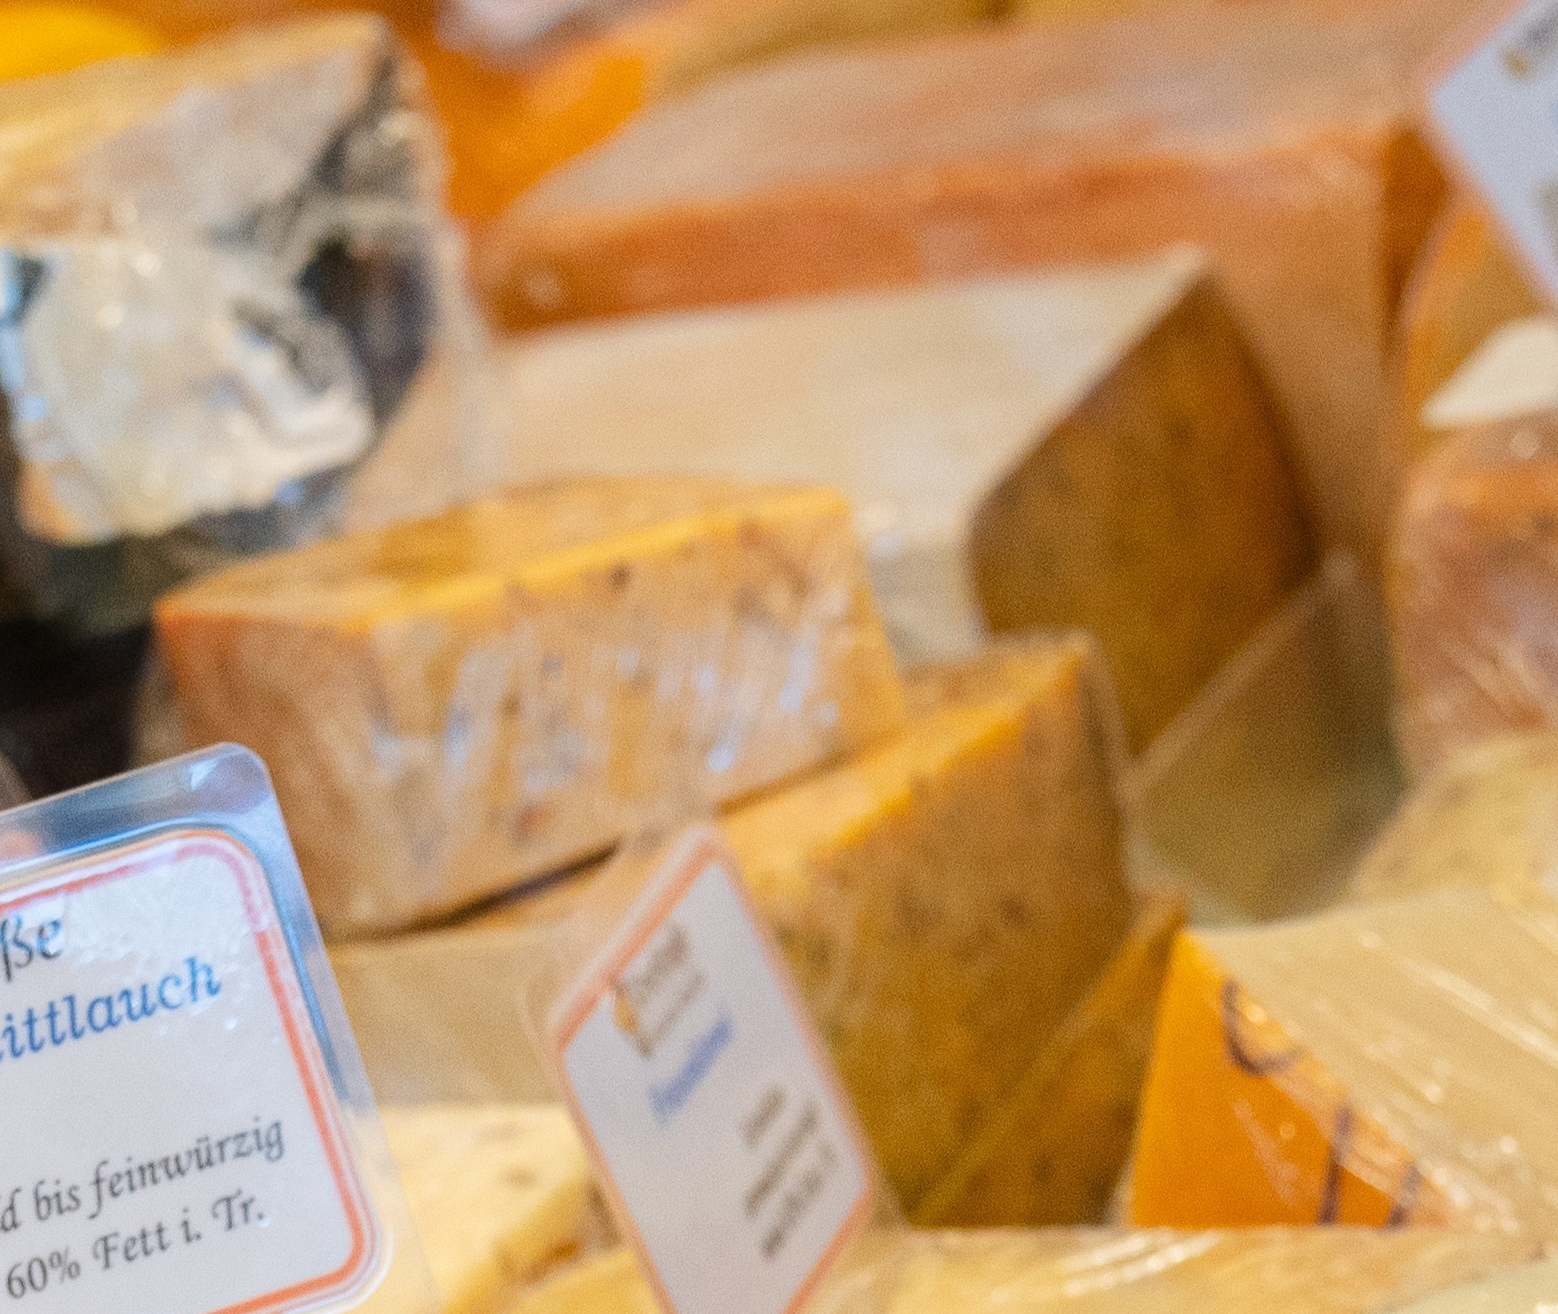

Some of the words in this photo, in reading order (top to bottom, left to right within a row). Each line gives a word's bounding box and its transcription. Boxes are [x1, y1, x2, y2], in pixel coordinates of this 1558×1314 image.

[33, 1178, 83, 1222] bis
[88, 1115, 286, 1220] feinwürzig
[5, 1247, 82, 1299] 60%
[93, 1220, 171, 1271] Fett
[181, 1207, 203, 1244] i.
[210, 1188, 265, 1232] Tr.
